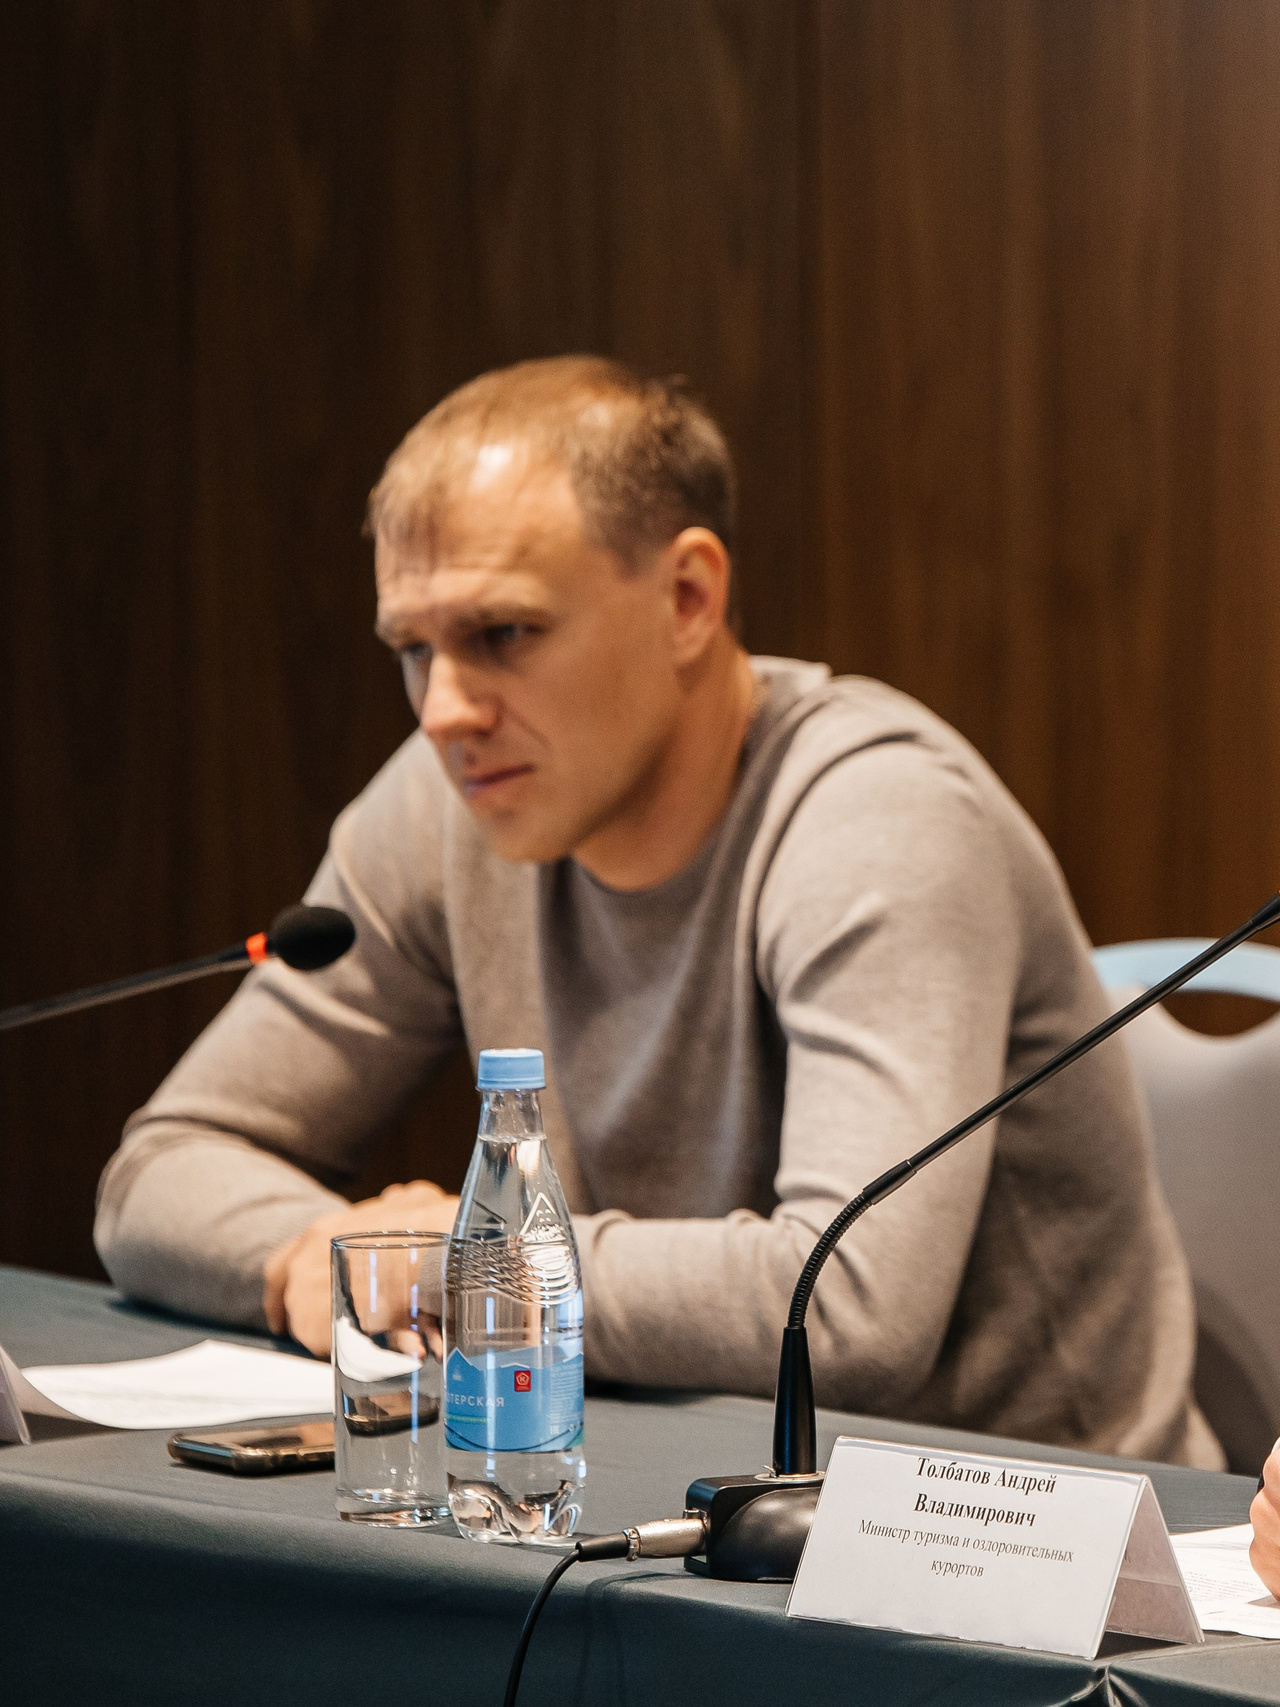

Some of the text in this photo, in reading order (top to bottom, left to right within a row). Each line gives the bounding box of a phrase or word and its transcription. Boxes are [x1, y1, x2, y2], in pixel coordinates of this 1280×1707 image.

[447, 1393, 505, 1407] ТЕРСКАЯ
[916, 1457, 1058, 1495] Толбатов Андрей
[913, 1493, 1037, 1527] Владимирович
[859, 1519, 1074, 1562] Министр туризма и оздоровительных
[931, 1559, 985, 1578] курортов
